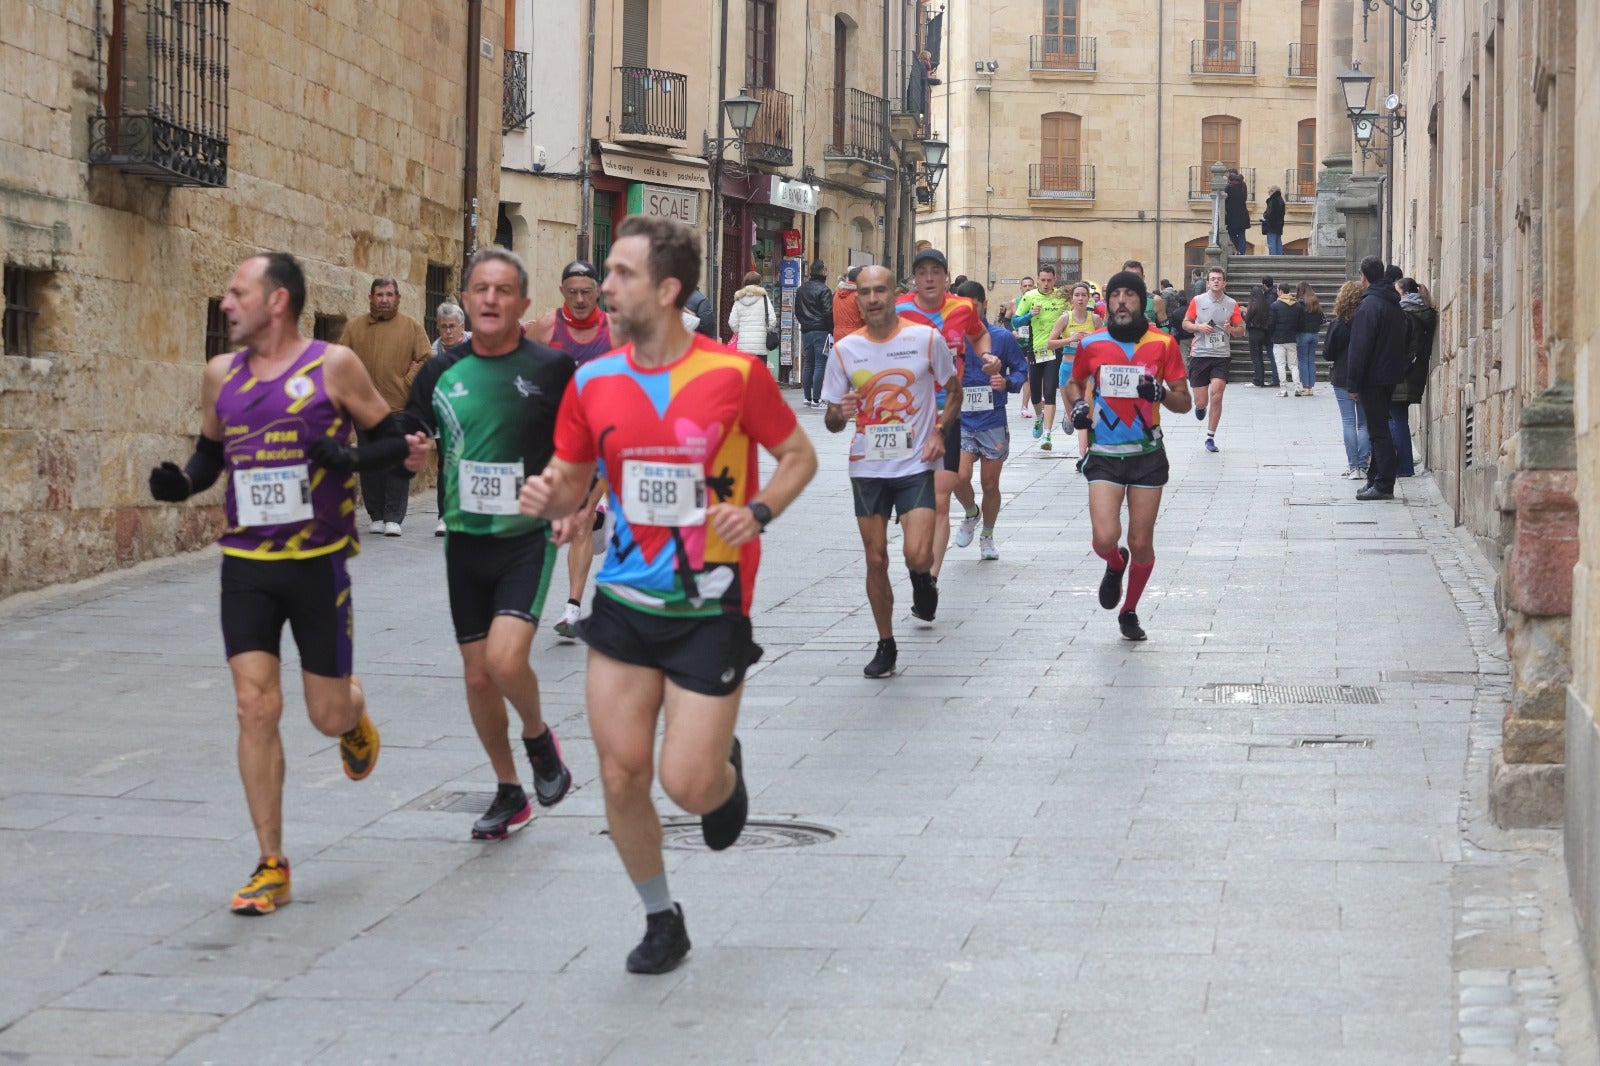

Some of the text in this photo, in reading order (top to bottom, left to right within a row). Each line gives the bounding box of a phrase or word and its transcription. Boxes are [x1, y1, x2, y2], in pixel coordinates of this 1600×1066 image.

[618, 163, 634, 174] away
[643, 166, 655, 176] café
[649, 194, 689, 220] SCALE
[1109, 374, 1130, 387] 304
[966, 393, 982, 403] 702
[874, 433, 897, 448] 273
[471, 475, 501, 497] 239
[639, 479, 677, 504] 688
[251, 483, 286, 506] 628
